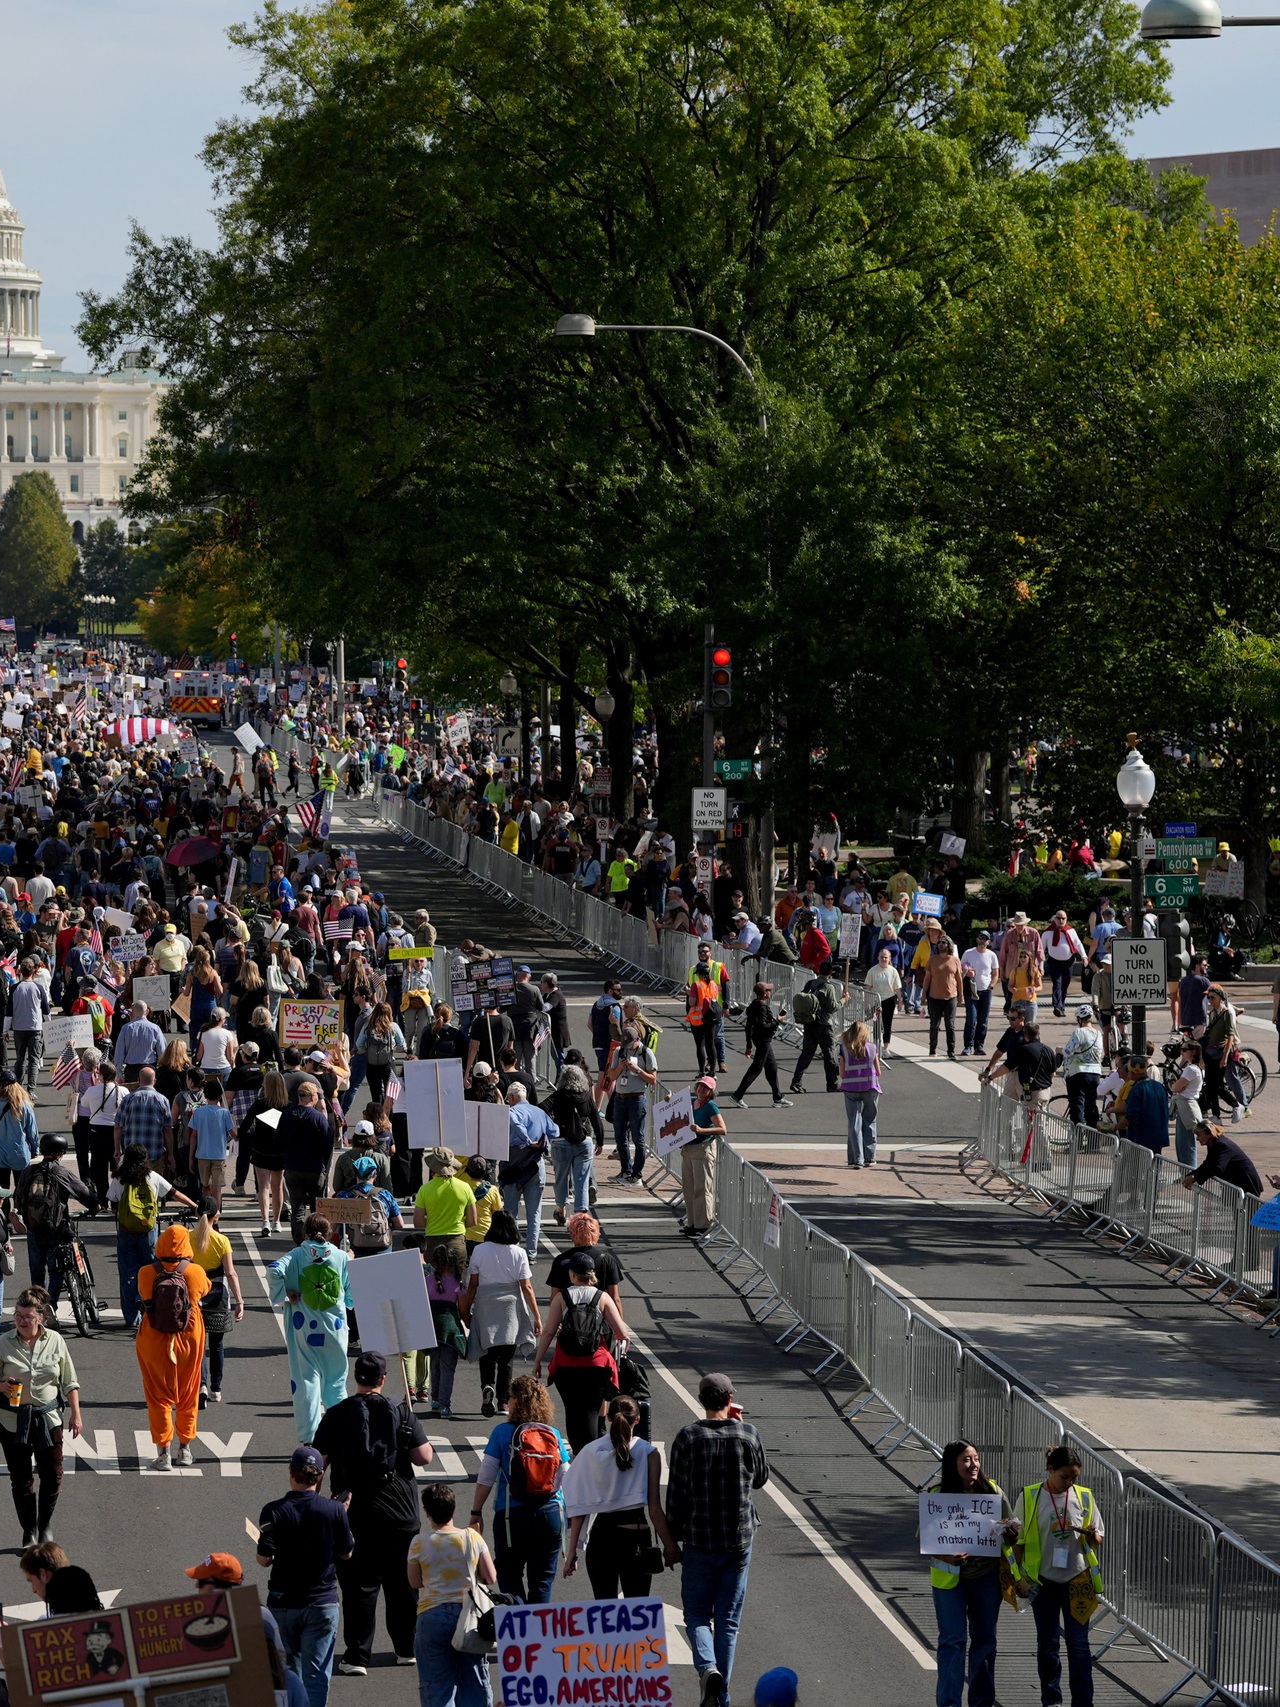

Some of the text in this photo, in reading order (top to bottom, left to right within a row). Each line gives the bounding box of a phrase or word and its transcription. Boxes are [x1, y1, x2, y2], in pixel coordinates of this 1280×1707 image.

[451, 726, 467, 738] 8647
[722, 762, 731, 772] 6
[1165, 826, 1195, 834] EVACUATION ROUTE
[1158, 840, 1213, 859] Pennsylvania Ave
[1205, 847, 1212, 855] NW
[1168, 859, 1189, 870] 600
[1230, 862, 1244, 870] GO
[1155, 878, 1167, 893] 6
[1182, 877, 1193, 885] ST
[1160, 895, 1184, 906] 200
[121, 937, 128, 945] My
[1129, 944, 1147, 955] NO
[1125, 959, 1154, 970] TURN
[1118, 974, 1160, 985] ON RED
[1114, 988, 1165, 1000] 7AM-7PM
[284, 1003, 340, 1020] PRIORITIZE
[300, 1013, 322, 1024] JOY
[48, 1024, 58, 1032] HEY
[314, 1023, 338, 1035] FREE
[47, 1036, 68, 1045] UNITARY
[317, 1034, 331, 1044] DC
[328, 1210, 364, 1221] TYRANT
[927, 1499, 995, 1518] the only ICE
[939, 1520, 982, 1533] is in my
[938, 1535, 997, 1548] matcha latte
[135, 1600, 206, 1624] TO FEED
[498, 1603, 663, 1640] AT THE FEAST
[138, 1623, 167, 1639] THE
[30, 1626, 75, 1649] TAX
[139, 1636, 185, 1659] HUNGRY
[35, 1646, 76, 1668] THE
[502, 1635, 667, 1674] OF TRUMP'S
[37, 1662, 91, 1688] RICH
[557, 1675, 673, 1706] AMERICANS
